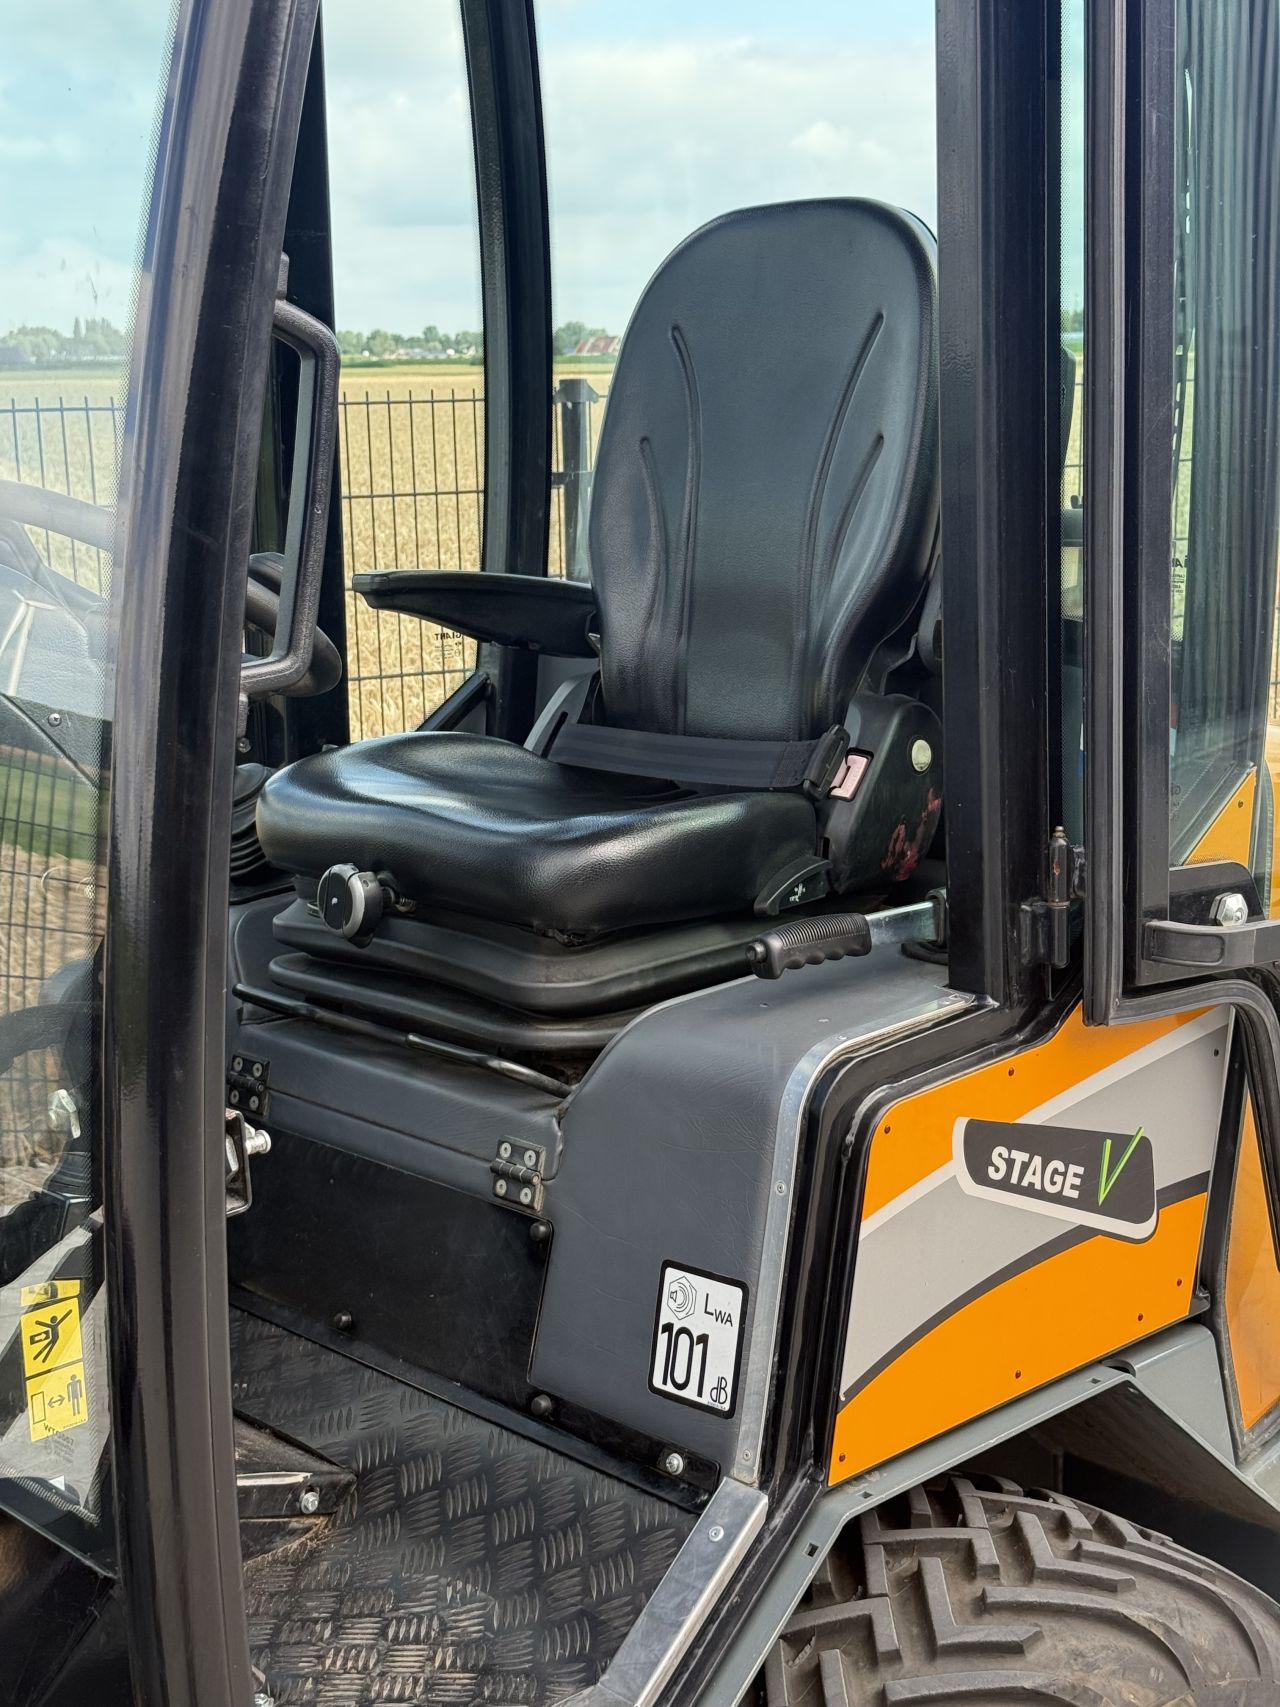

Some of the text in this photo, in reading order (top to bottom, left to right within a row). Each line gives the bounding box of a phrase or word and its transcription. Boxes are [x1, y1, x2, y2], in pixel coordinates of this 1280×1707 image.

[987, 1126, 1145, 1207] STAGE V
[660, 1321, 728, 1405] 101 dB
